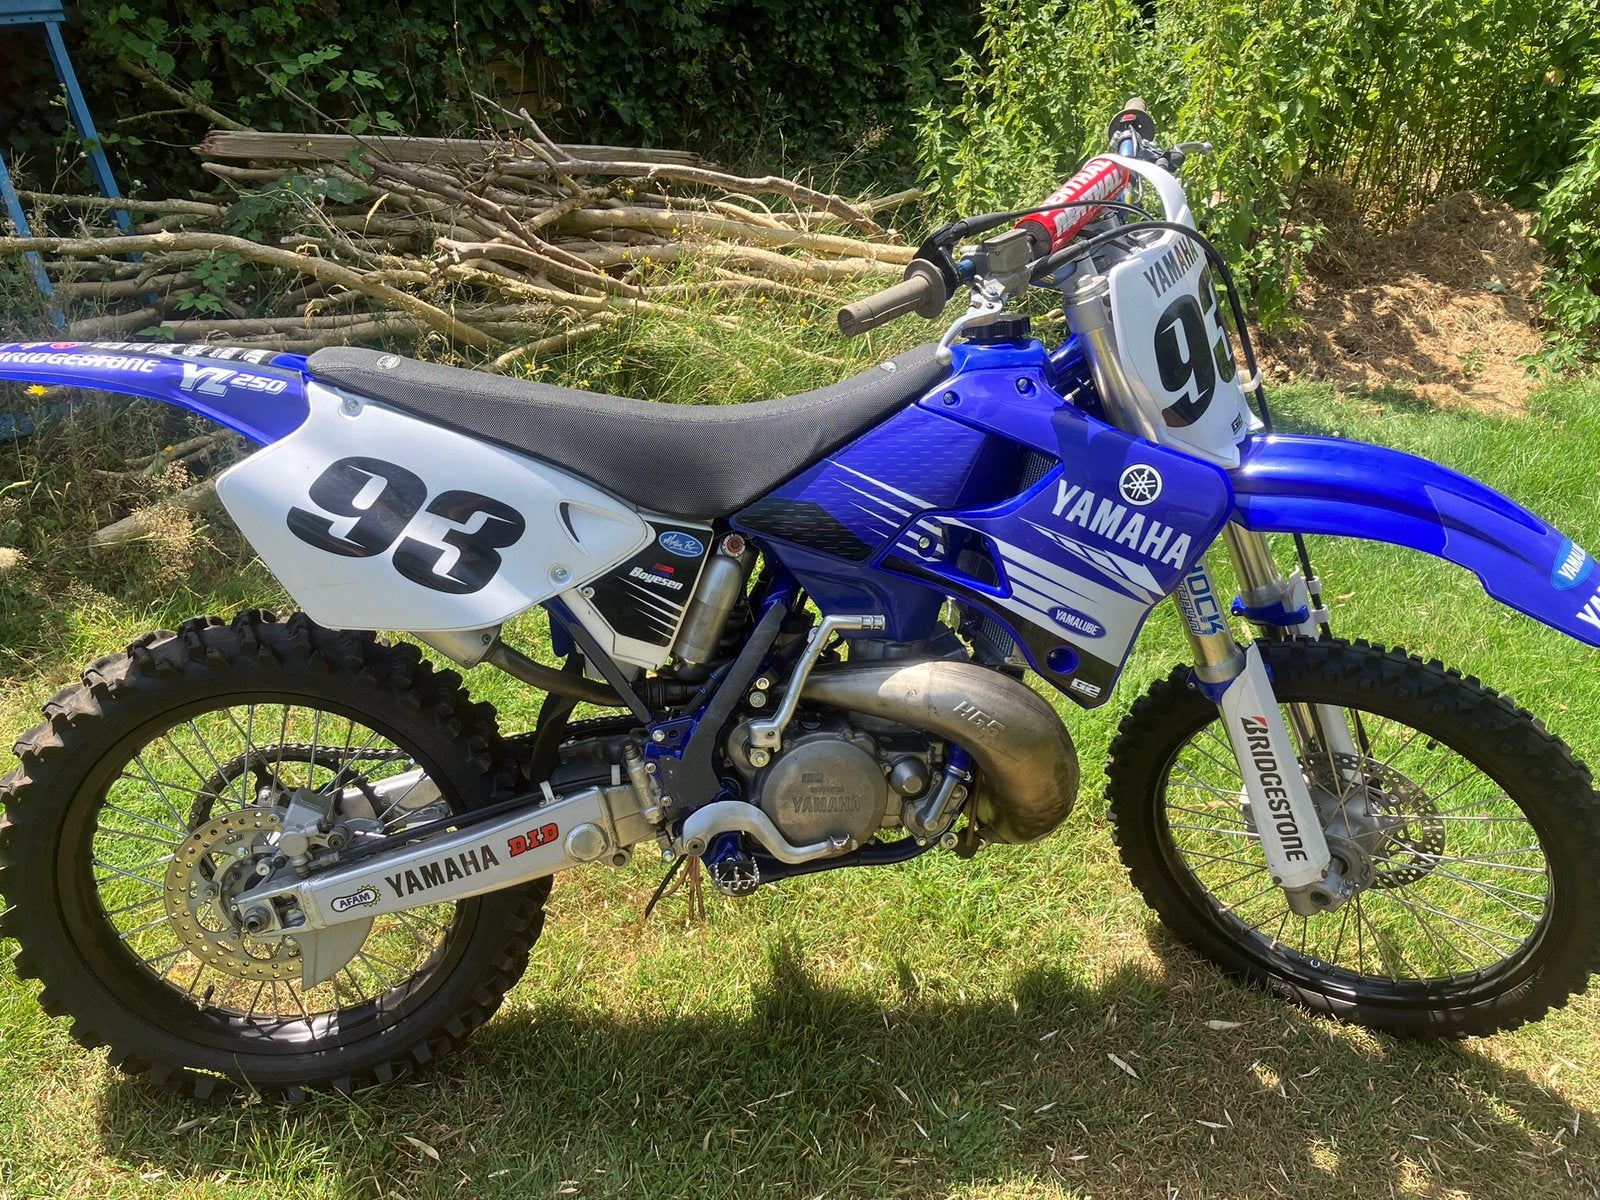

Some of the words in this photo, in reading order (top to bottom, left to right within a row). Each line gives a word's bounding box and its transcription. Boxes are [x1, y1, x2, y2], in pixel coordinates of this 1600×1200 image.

[1142, 235, 1200, 299] YAMAHA
[1154, 262, 1237, 428] 93
[179, 362, 238, 397] YZ
[230, 373, 288, 395] 250
[286, 456, 526, 595] 93
[1051, 478, 1192, 570] YAMAHA
[629, 566, 684, 591] Boyesen
[1055, 609, 1099, 637] YAMALUBE
[792, 795, 861, 813] YAMAHA
[1240, 715, 1308, 863] BRIDGESTONE
[384, 844, 500, 899] YAMAHA
[338, 891, 371, 909] AFAM
